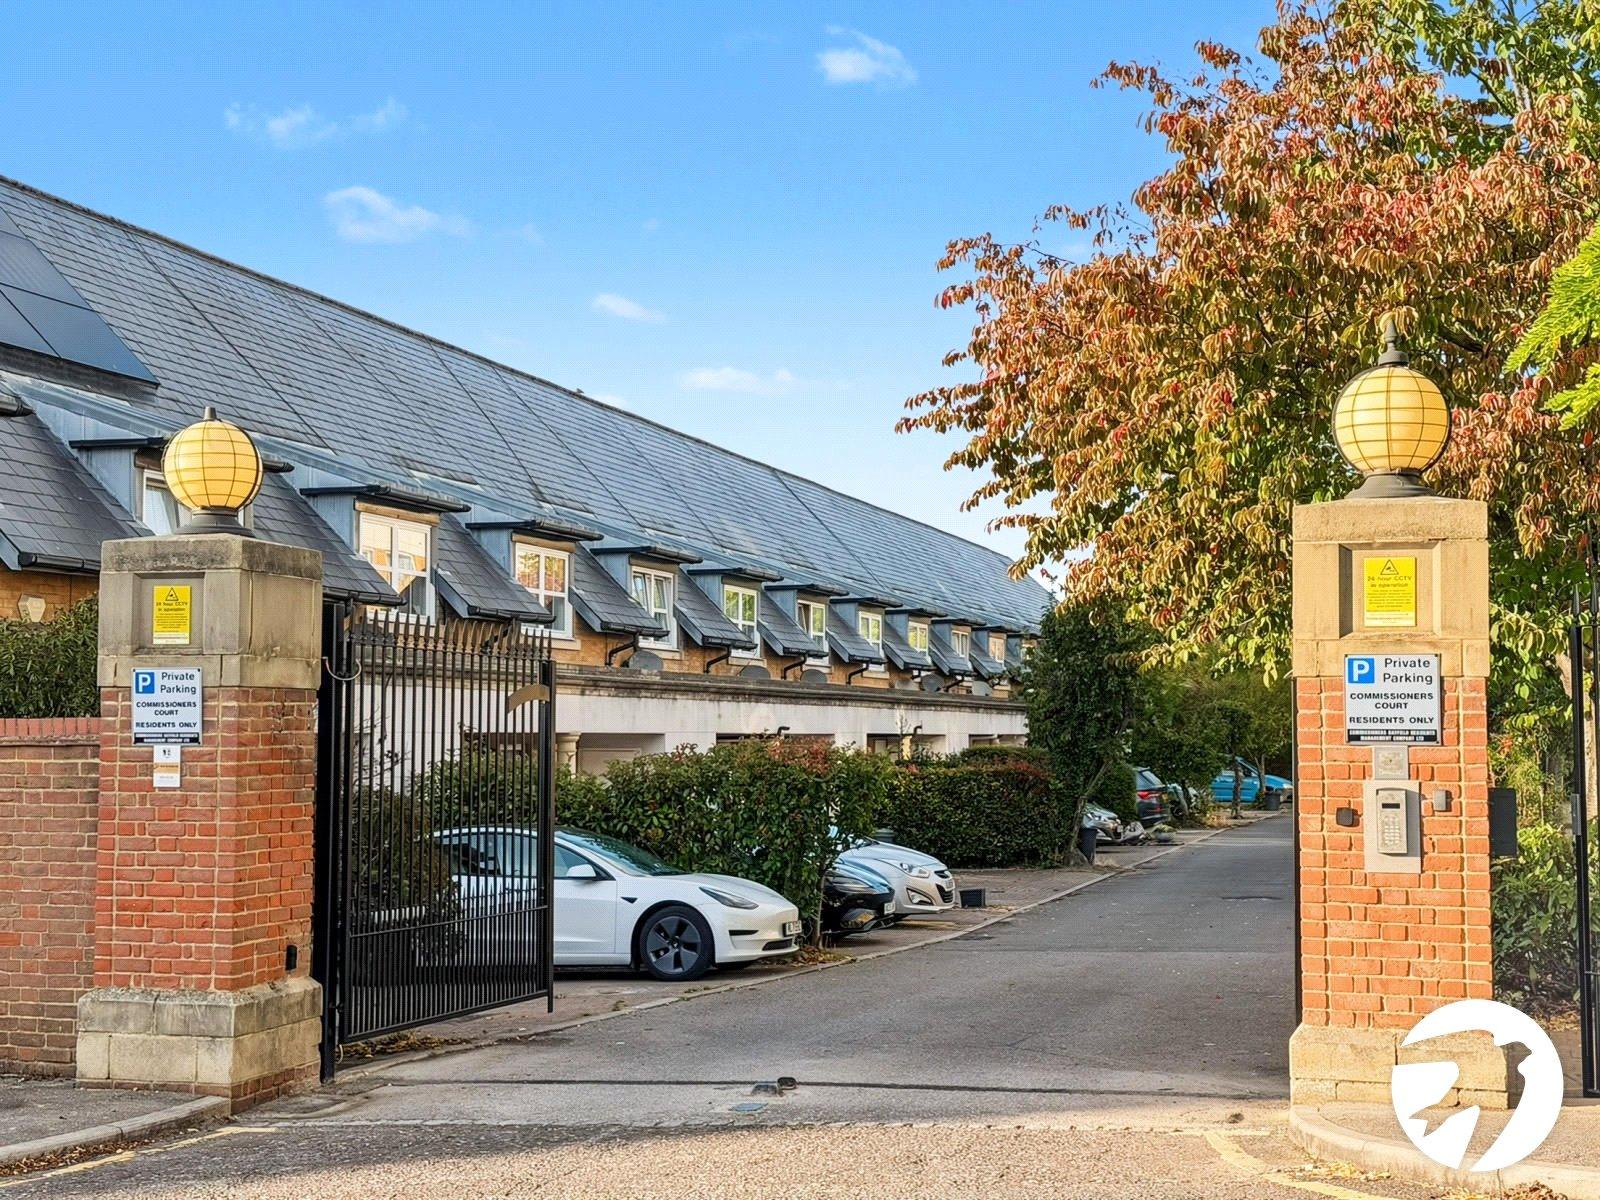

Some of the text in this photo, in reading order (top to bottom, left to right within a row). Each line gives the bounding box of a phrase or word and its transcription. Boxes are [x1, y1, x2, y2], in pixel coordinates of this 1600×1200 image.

[1384, 658, 1430, 668] Private
[162, 672, 195, 680] Private
[1383, 672, 1433, 685] Parking
[160, 684, 196, 695] Parking
